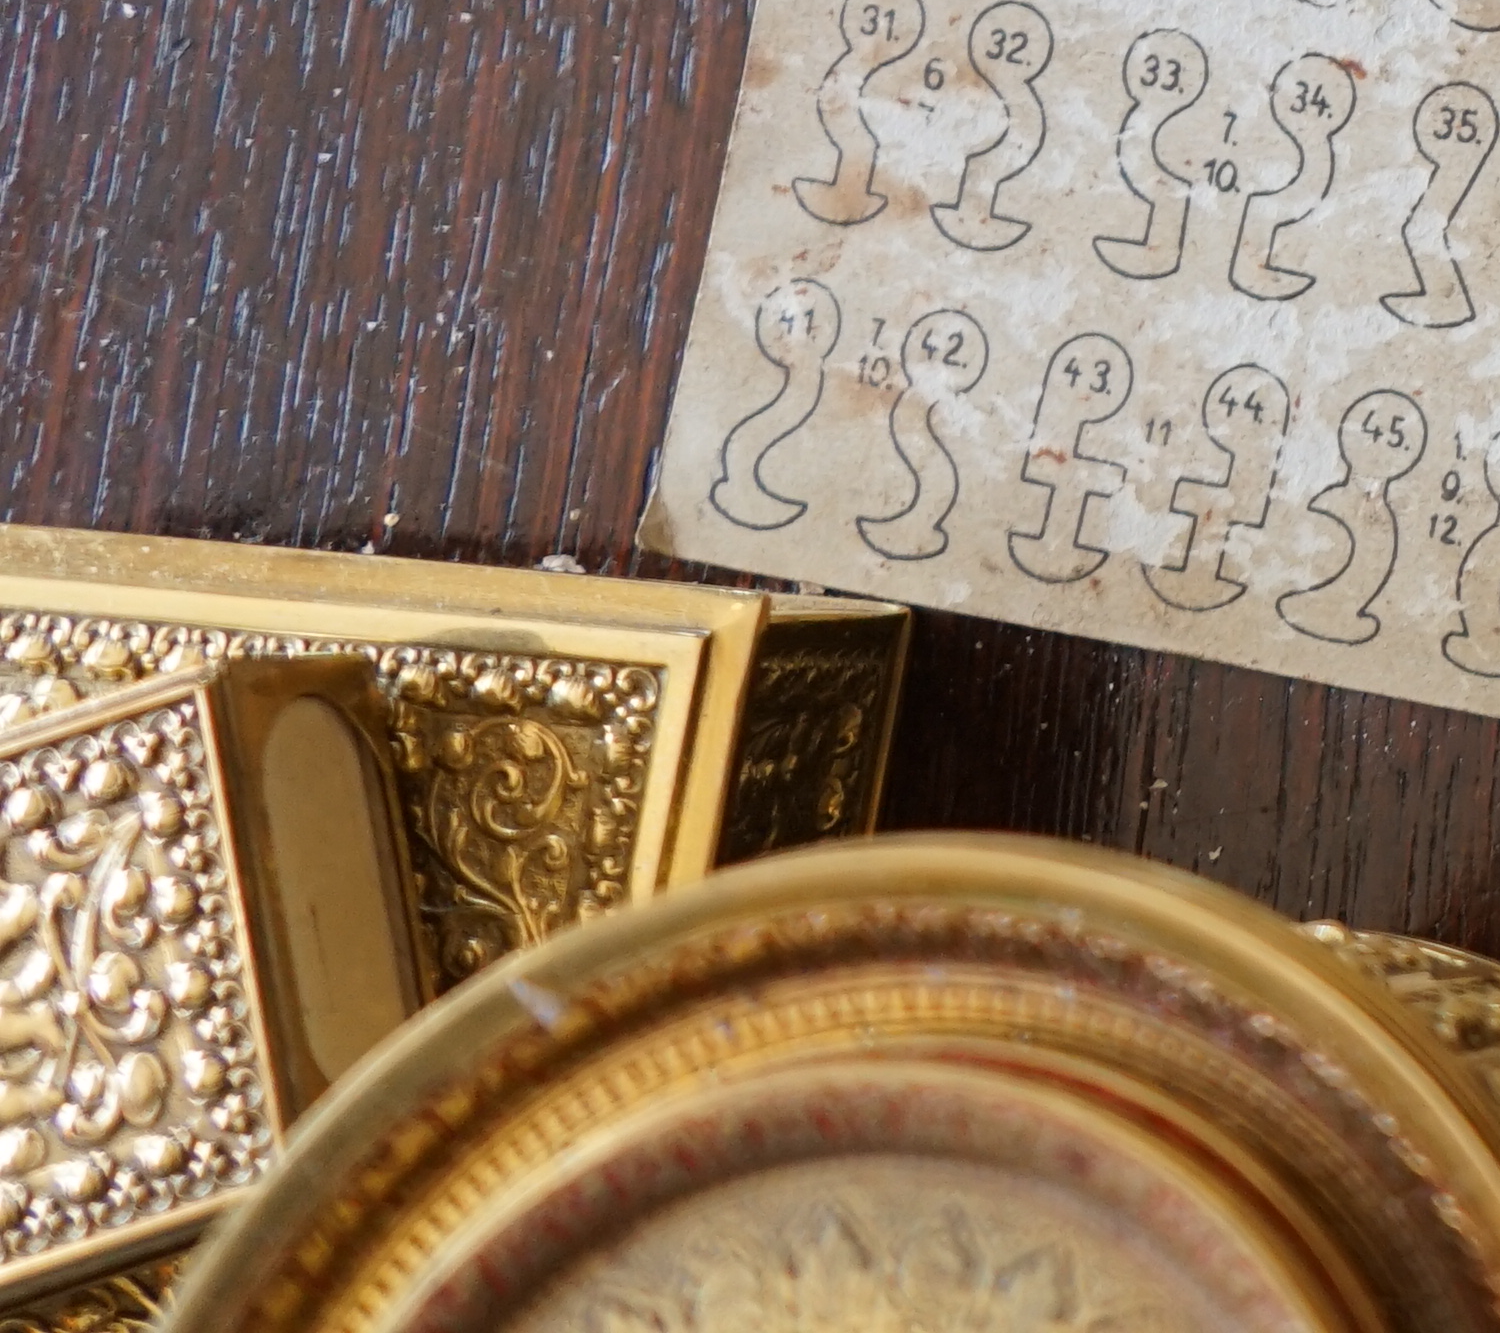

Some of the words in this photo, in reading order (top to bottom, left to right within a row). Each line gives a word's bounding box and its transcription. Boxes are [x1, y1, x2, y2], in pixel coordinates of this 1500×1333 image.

[859, 4, 900, 42] 31.
[985, 28, 1031, 67] 32.
[1140, 54, 1184, 95] 33.
[1289, 80, 1333, 119] 34.
[1432, 105, 1482, 146] 35.
[1200, 157, 1244, 194] 10.
[921, 328, 968, 369] 42.
[1063, 357, 1112, 396] 43.
[1361, 411, 1410, 452] 45.
